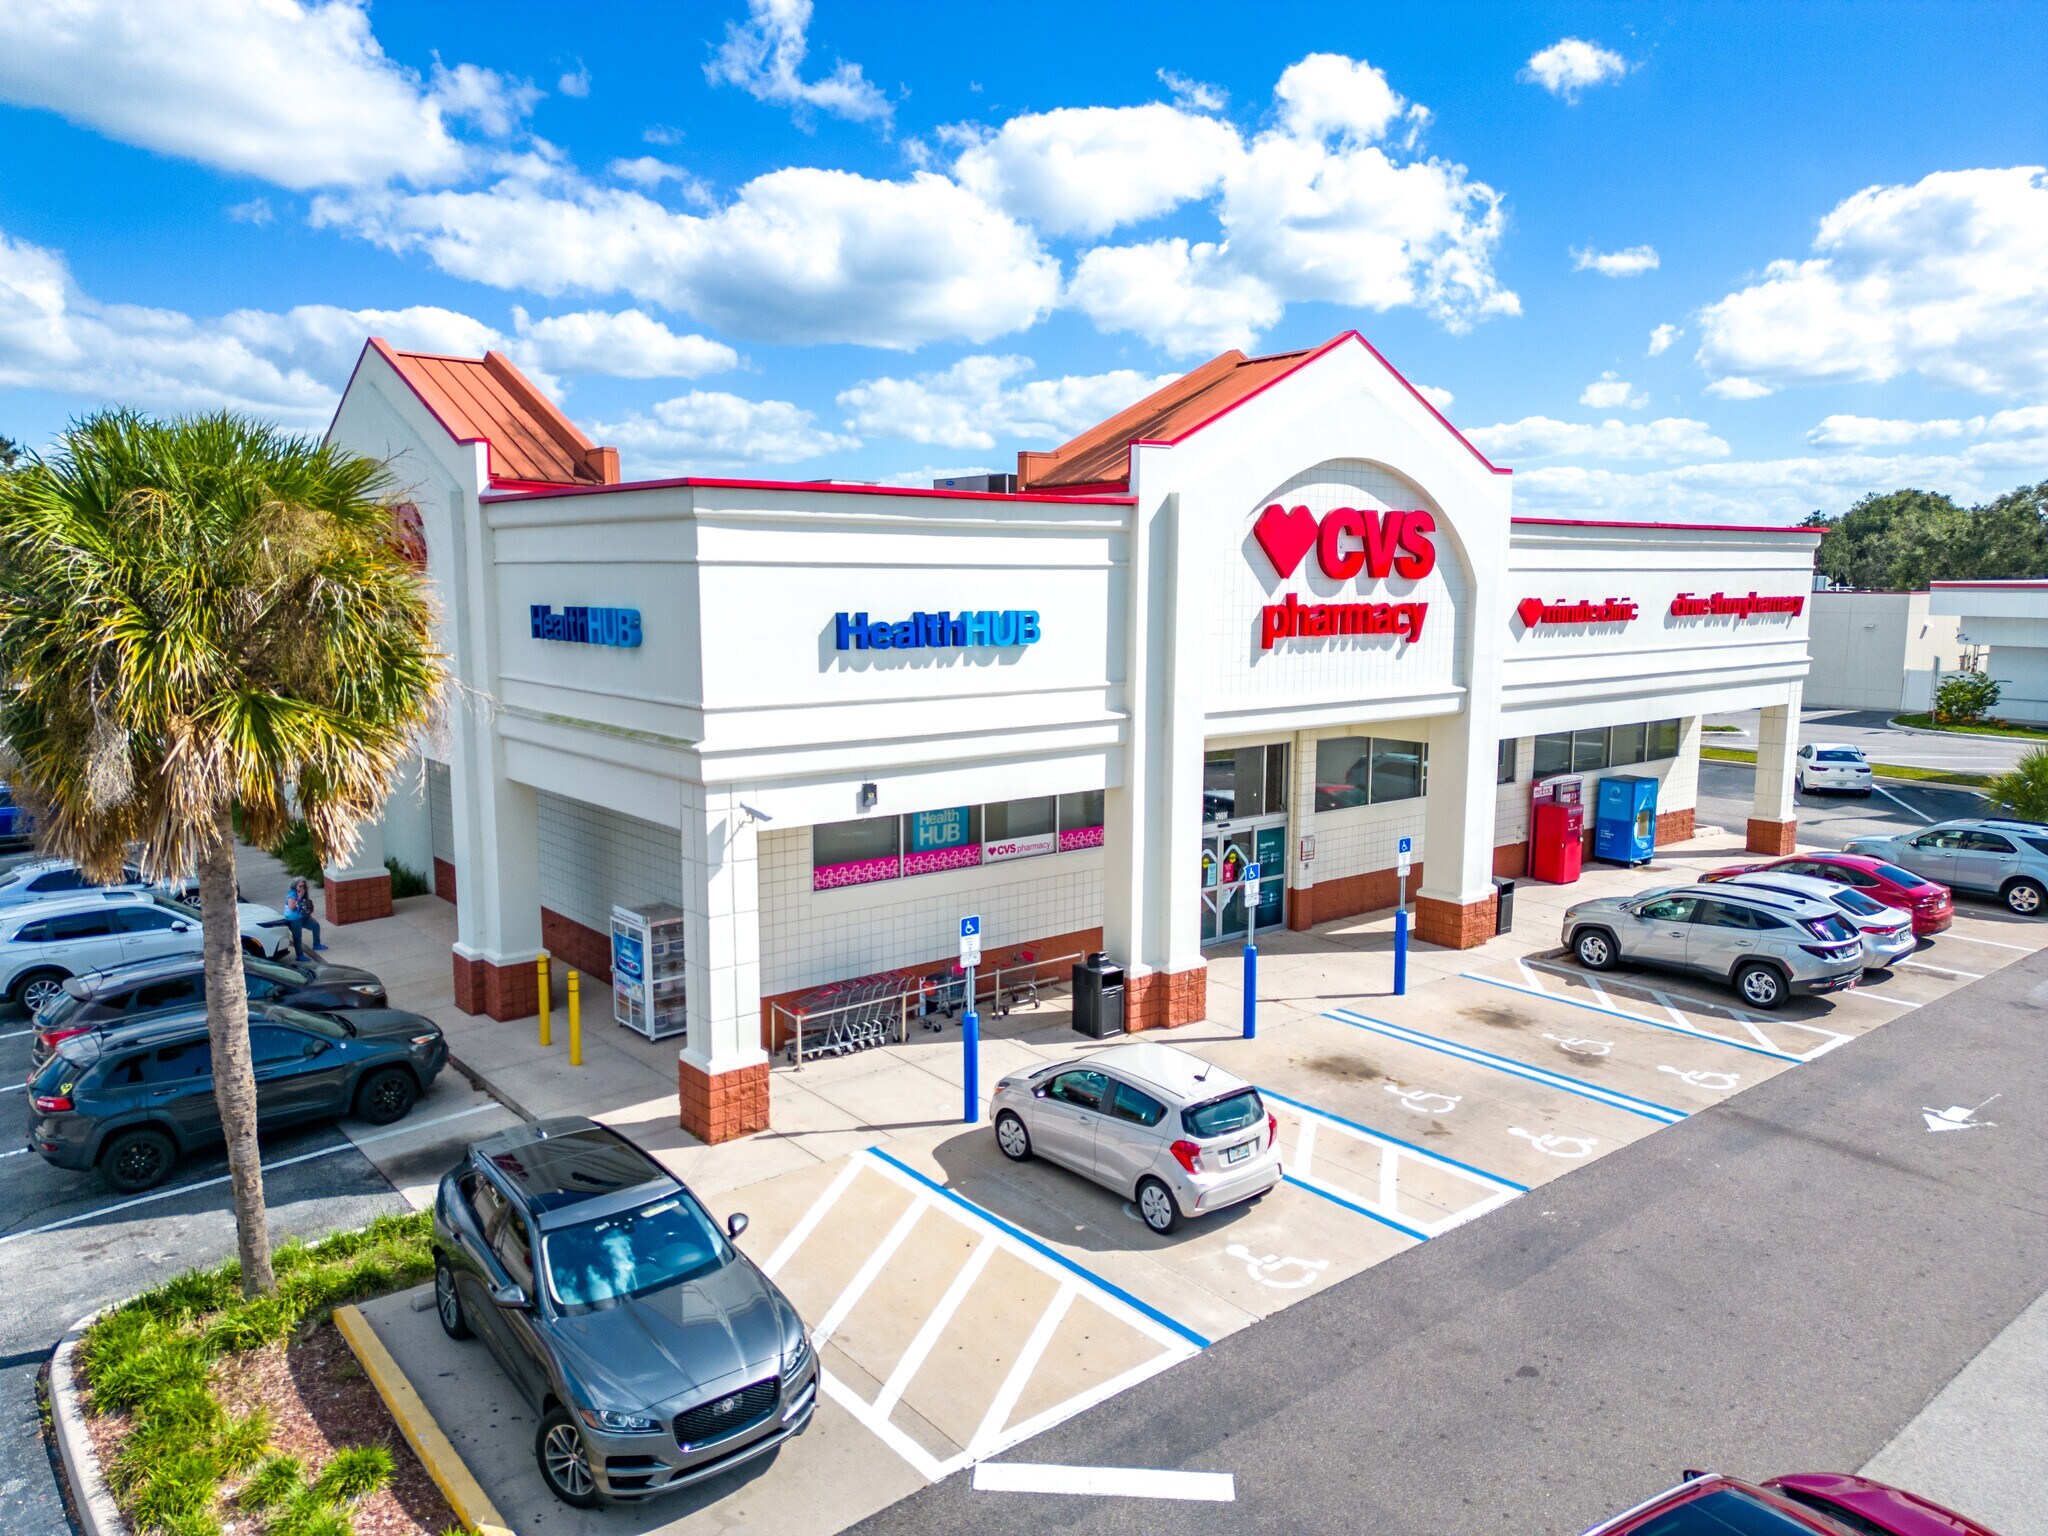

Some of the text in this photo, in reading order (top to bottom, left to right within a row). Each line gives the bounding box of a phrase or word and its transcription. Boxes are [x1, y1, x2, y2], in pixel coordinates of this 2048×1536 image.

[1317, 507, 1436, 580] CVS
[1262, 593, 1429, 649] pharmacy
[1739, 592, 1805, 619] pharmacy
[530, 605, 643, 648] HealthHUB
[836, 610, 1042, 650] HealthHUB
[919, 809, 960, 826] Health
[919, 823, 961, 846] HUB
[997, 841, 1050, 855] CVS pharmacy
